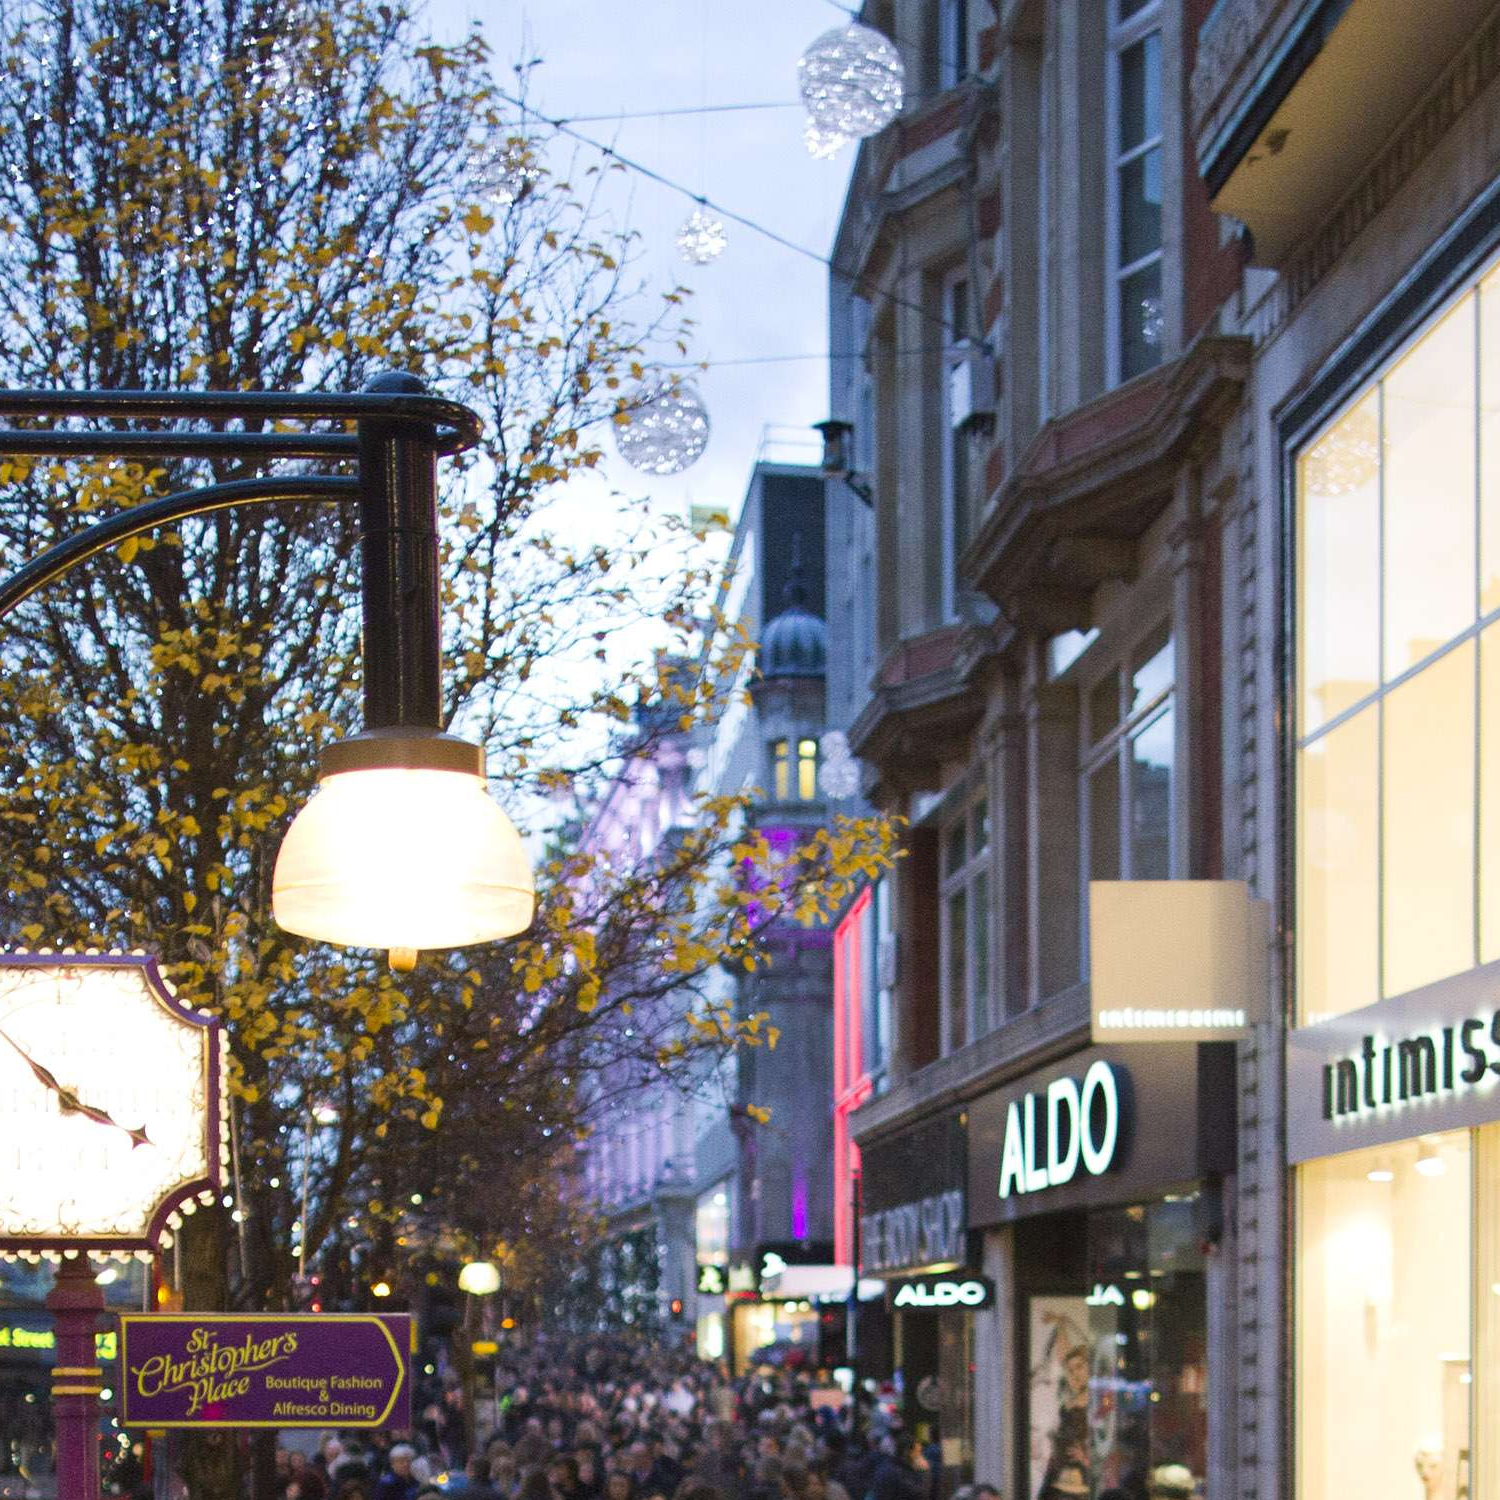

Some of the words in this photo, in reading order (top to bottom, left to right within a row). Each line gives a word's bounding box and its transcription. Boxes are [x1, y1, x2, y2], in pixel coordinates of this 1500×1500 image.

[998, 1060, 1119, 1199] ALDO
[894, 1281, 986, 1306] ALDO
[131, 1331, 299, 1398] Christopher's
[186, 1376, 250, 1416] Place
[266, 1376, 327, 1392] Boutique
[330, 1376, 382, 1389] Fashion
[273, 1402, 328, 1416] Alfresco
[330, 1402, 376, 1417] Dining
[319, 1392, 330, 1402] &
